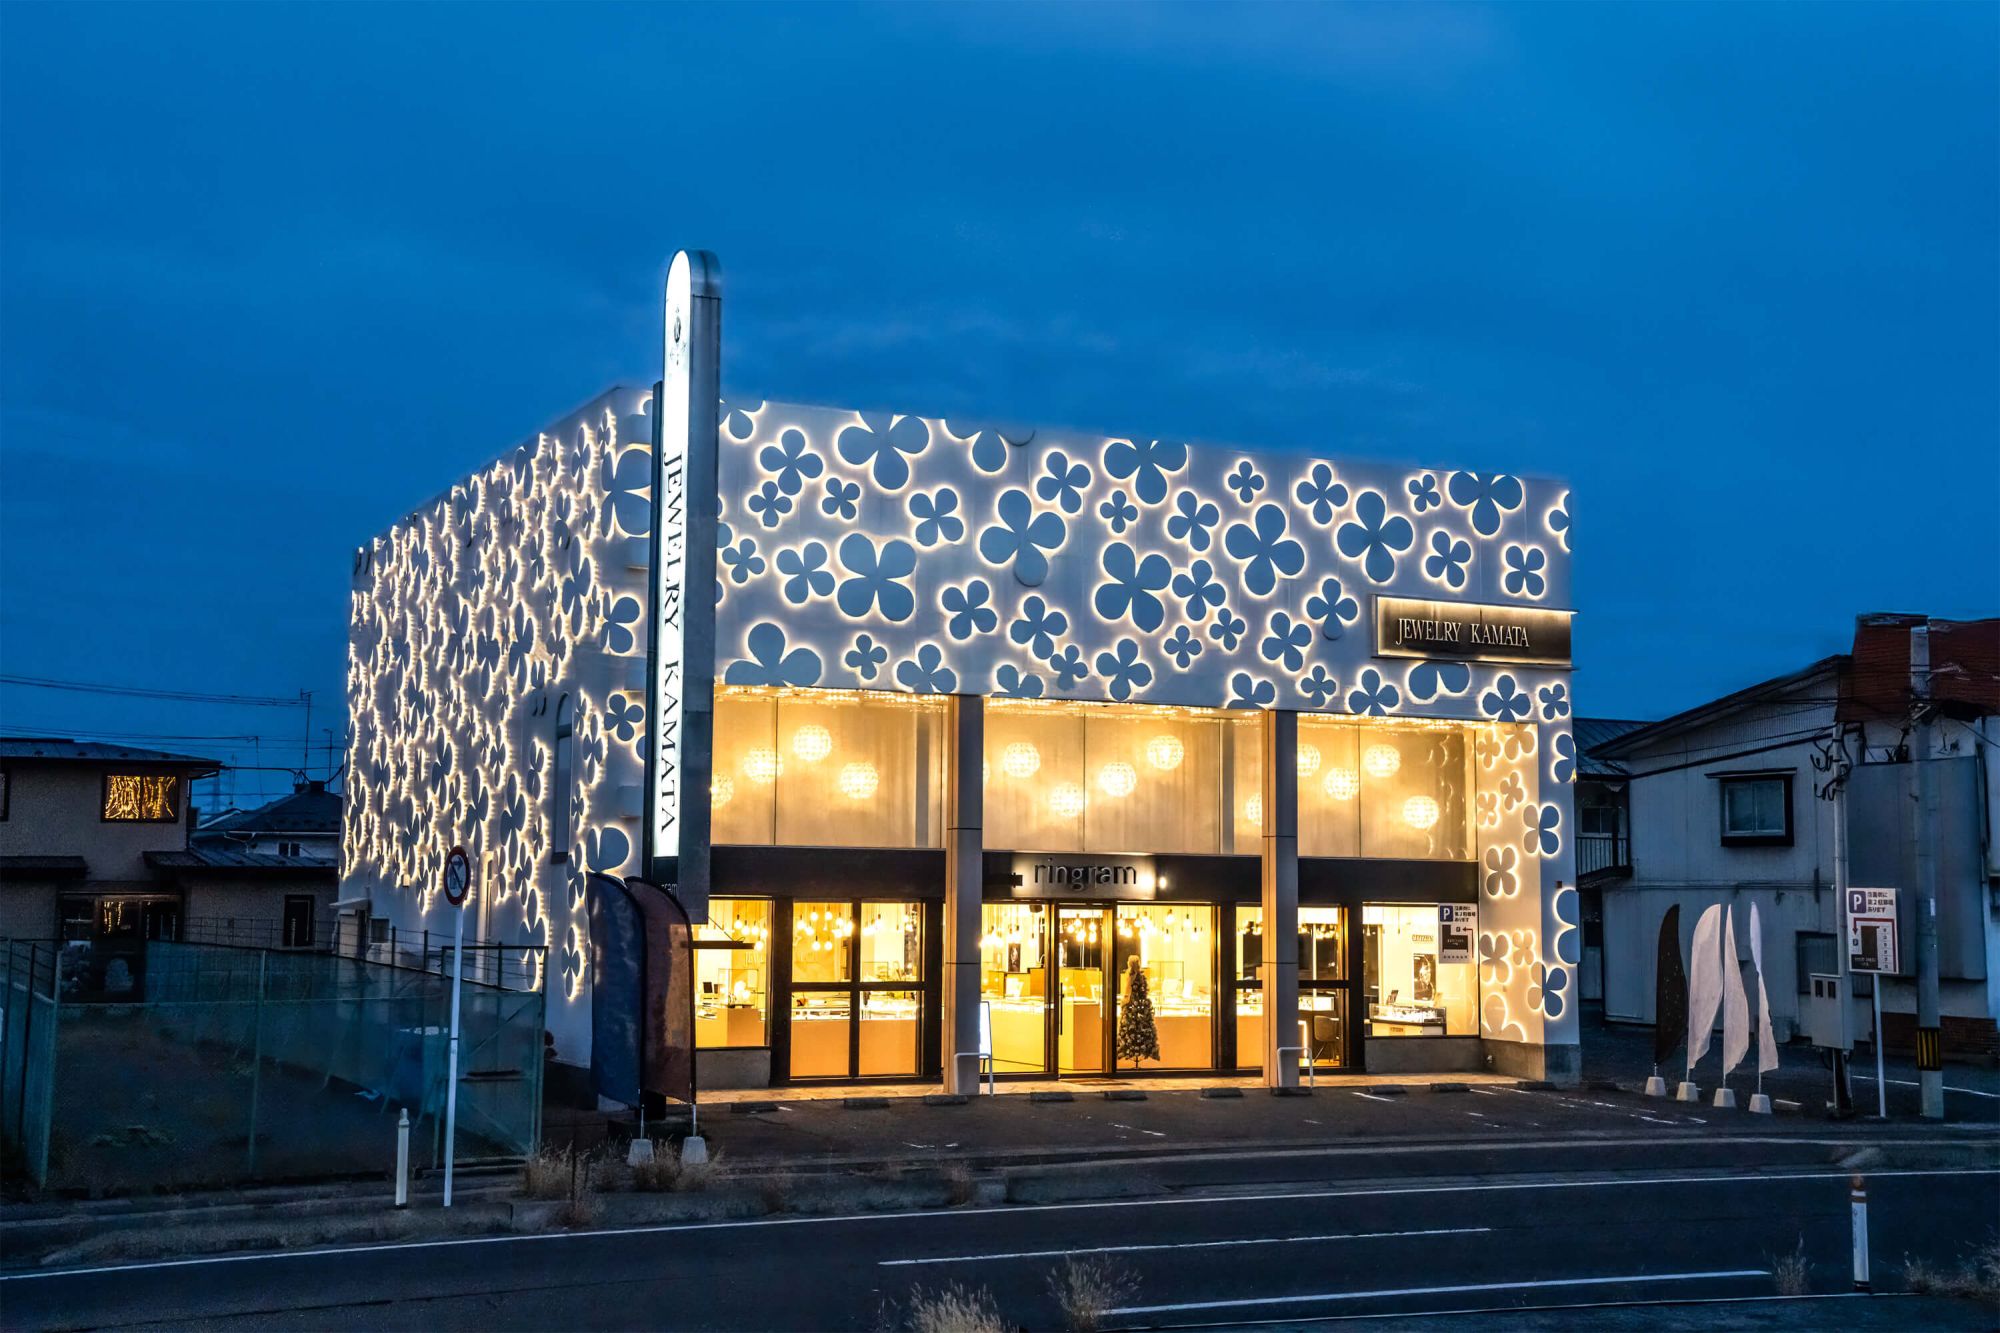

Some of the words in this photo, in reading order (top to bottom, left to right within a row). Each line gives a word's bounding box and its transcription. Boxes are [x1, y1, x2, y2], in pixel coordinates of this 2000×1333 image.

[663, 451, 683, 632] JEWELRY
[1395, 617, 1462, 646] JEWELRY
[1469, 622, 1531, 648] KAMATA
[660, 660, 680, 833] KAMATA
[1033, 857, 1137, 892] ringram
[1443, 907, 1451, 920] P
[1853, 893, 1862, 911] P
